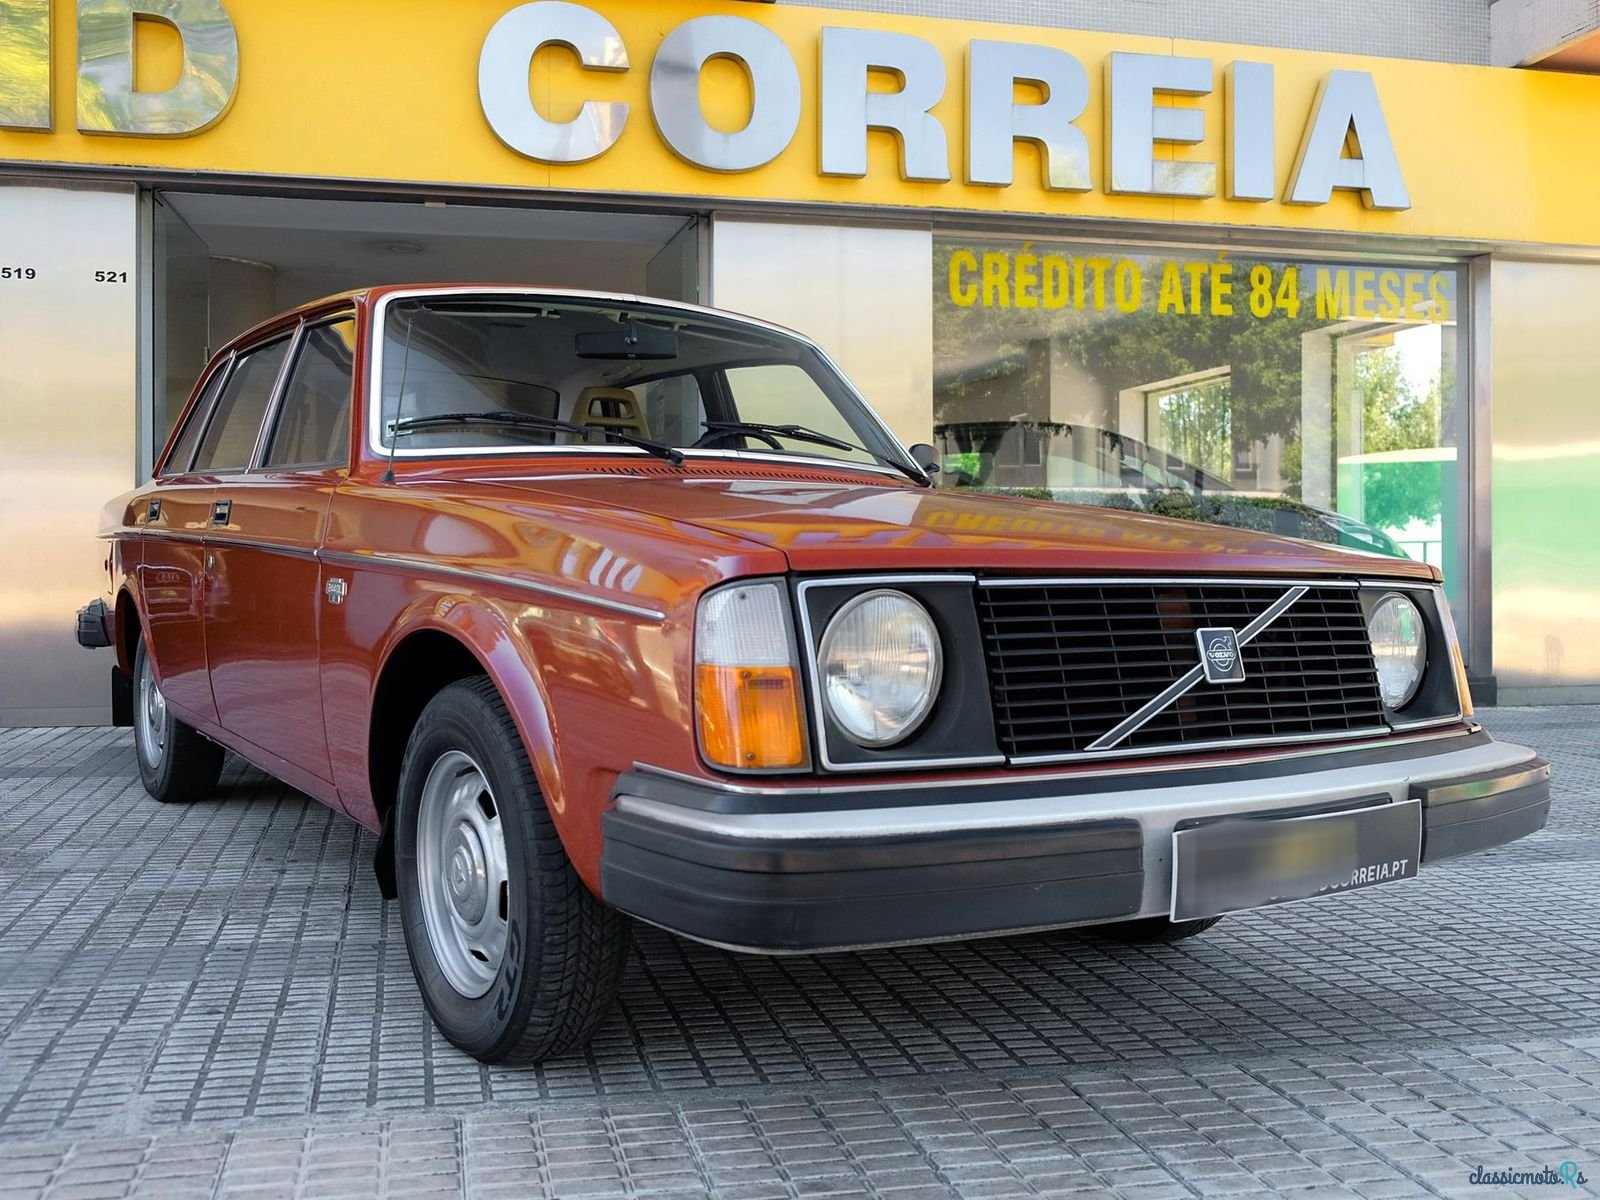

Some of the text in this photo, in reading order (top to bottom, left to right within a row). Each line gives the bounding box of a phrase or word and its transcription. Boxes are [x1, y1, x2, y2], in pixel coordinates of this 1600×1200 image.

[478, 0, 1411, 211] CORREIA
[1, 267, 36, 280] 519
[95, 270, 127, 283] 521
[949, 240, 1449, 324] CRÉDITO ATÉ 84 MESES
[1208, 651, 1235, 659] VOLVO
[1319, 859, 1408, 892] RREIA.PT
